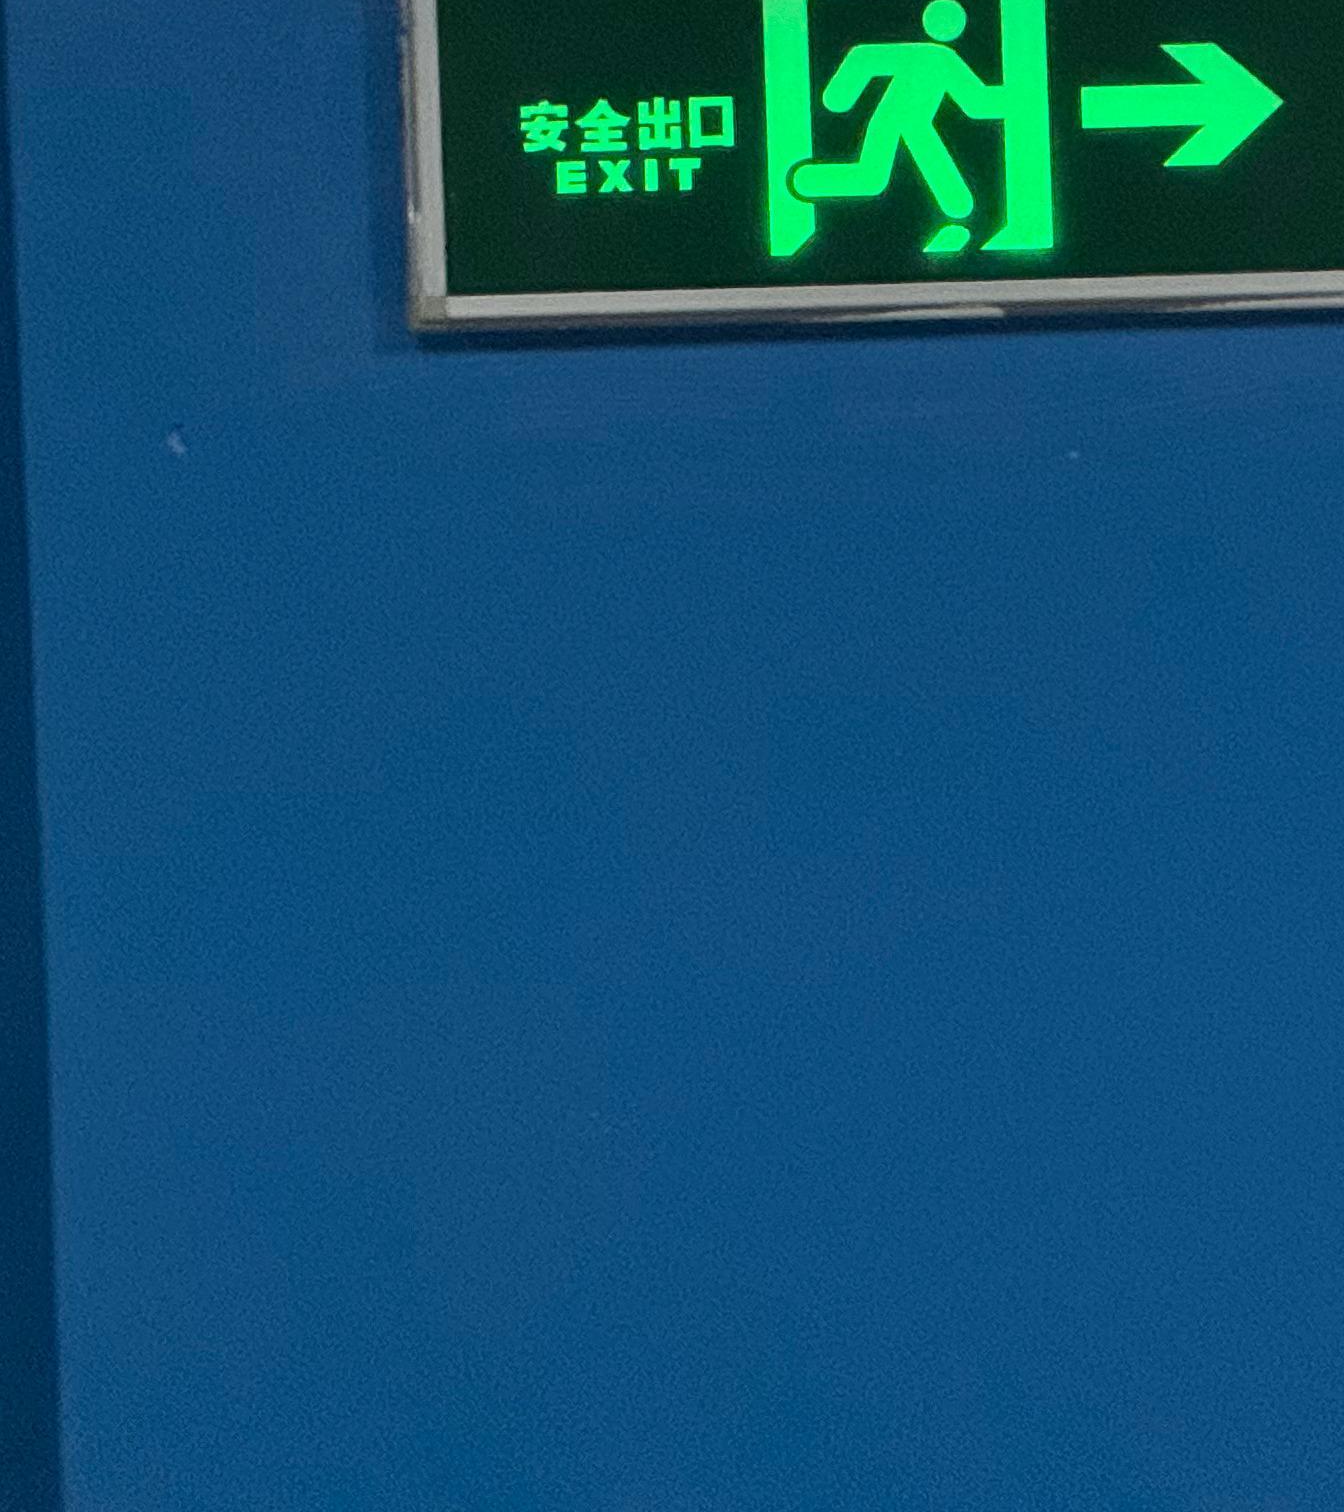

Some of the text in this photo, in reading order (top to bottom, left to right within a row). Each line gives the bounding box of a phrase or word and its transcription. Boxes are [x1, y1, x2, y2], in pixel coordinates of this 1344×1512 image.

[518, 95, 735, 153] 安全出口
[555, 156, 702, 195] EXIT
